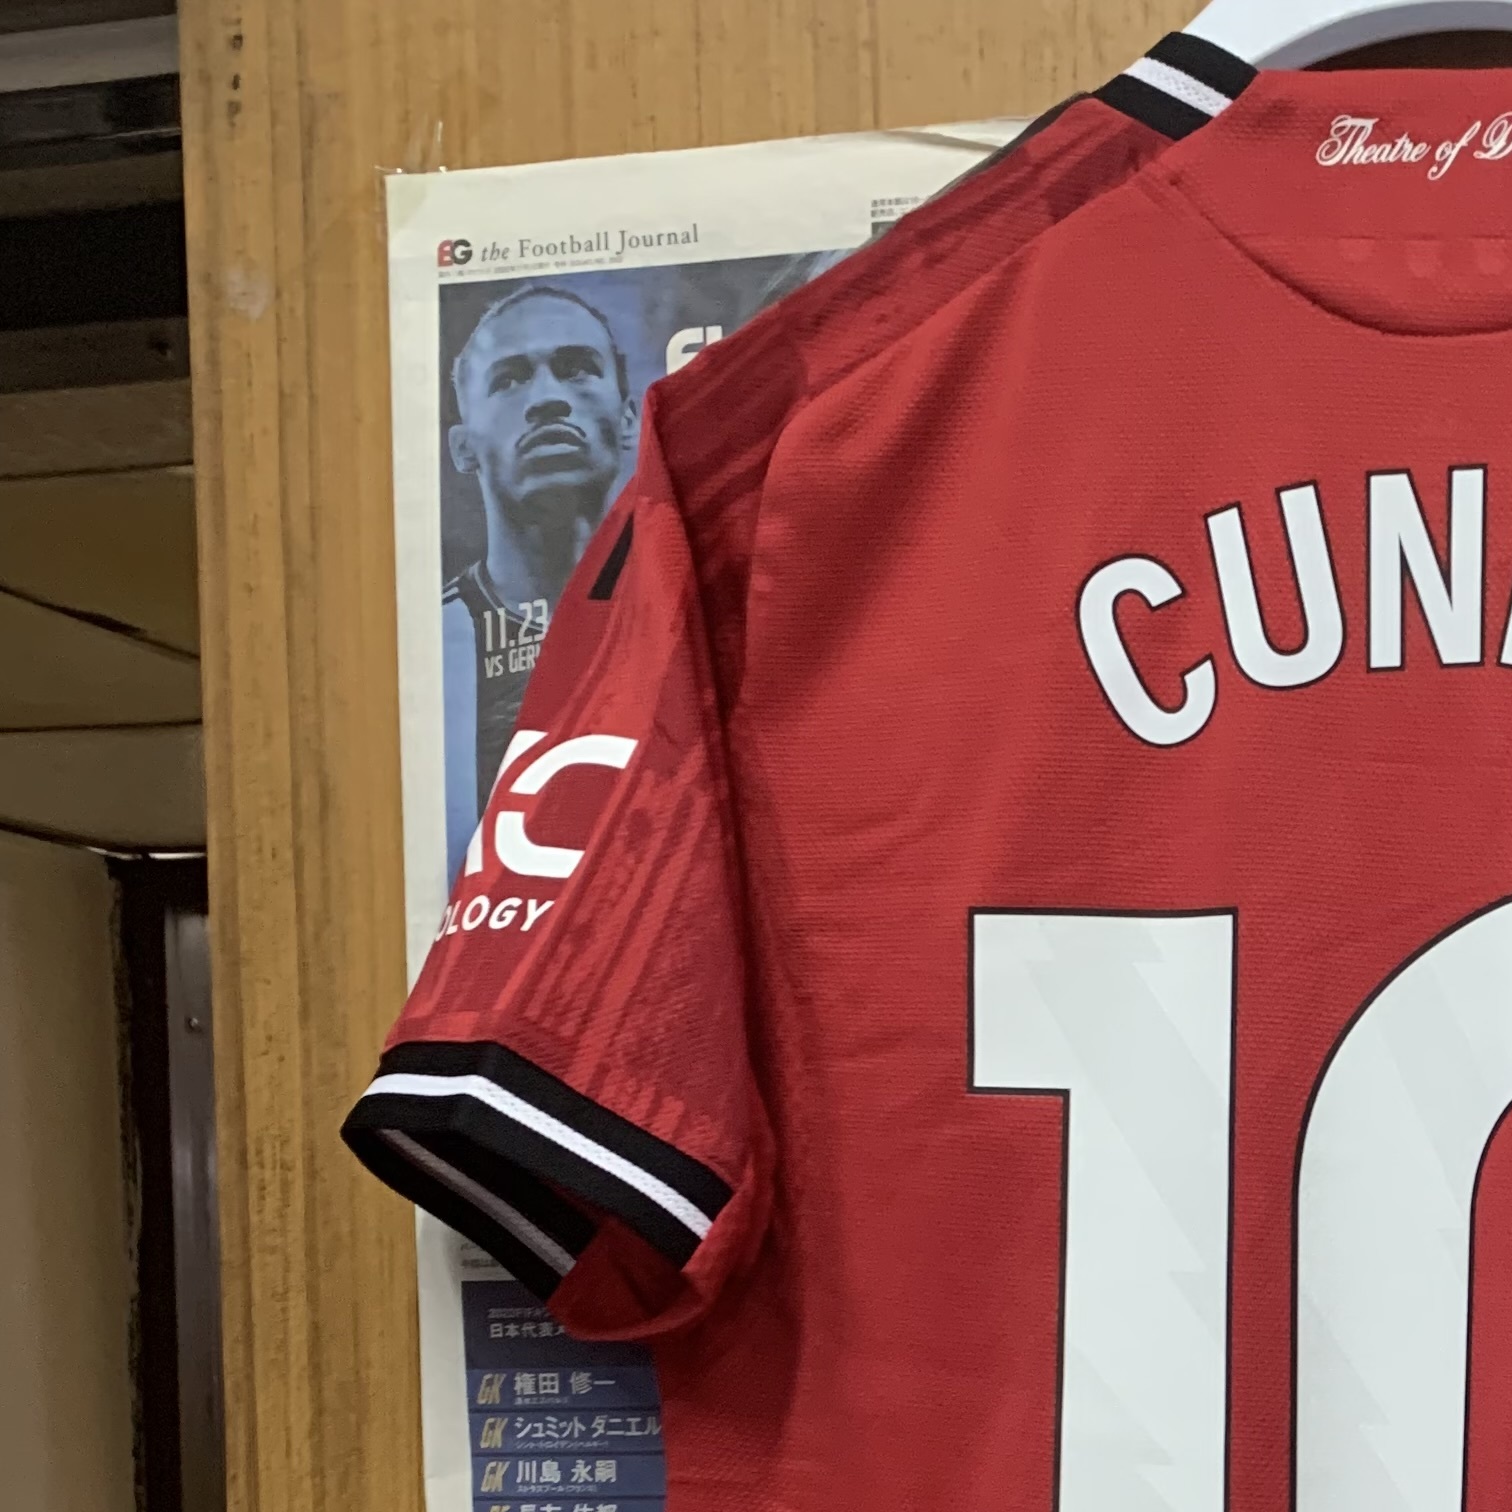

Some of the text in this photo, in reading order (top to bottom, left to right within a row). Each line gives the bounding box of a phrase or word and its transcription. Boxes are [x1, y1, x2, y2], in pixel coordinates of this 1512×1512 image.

[1315, 114, 1431, 166] Theatre
[1427, 121, 1481, 180] of
[480, 241, 511, 263] the
[518, 231, 610, 258] Football
[615, 223, 700, 255] Journal
[483, 598, 549, 652] 11.23
[484, 654, 504, 679] VS
[570, 1371, 616, 1395] 修一
[513, 1415, 587, 1439] シュミット
[590, 1414, 663, 1438] ダニエル
[480, 1461, 511, 1493] GK
[515, 1459, 562, 1484] 川島
